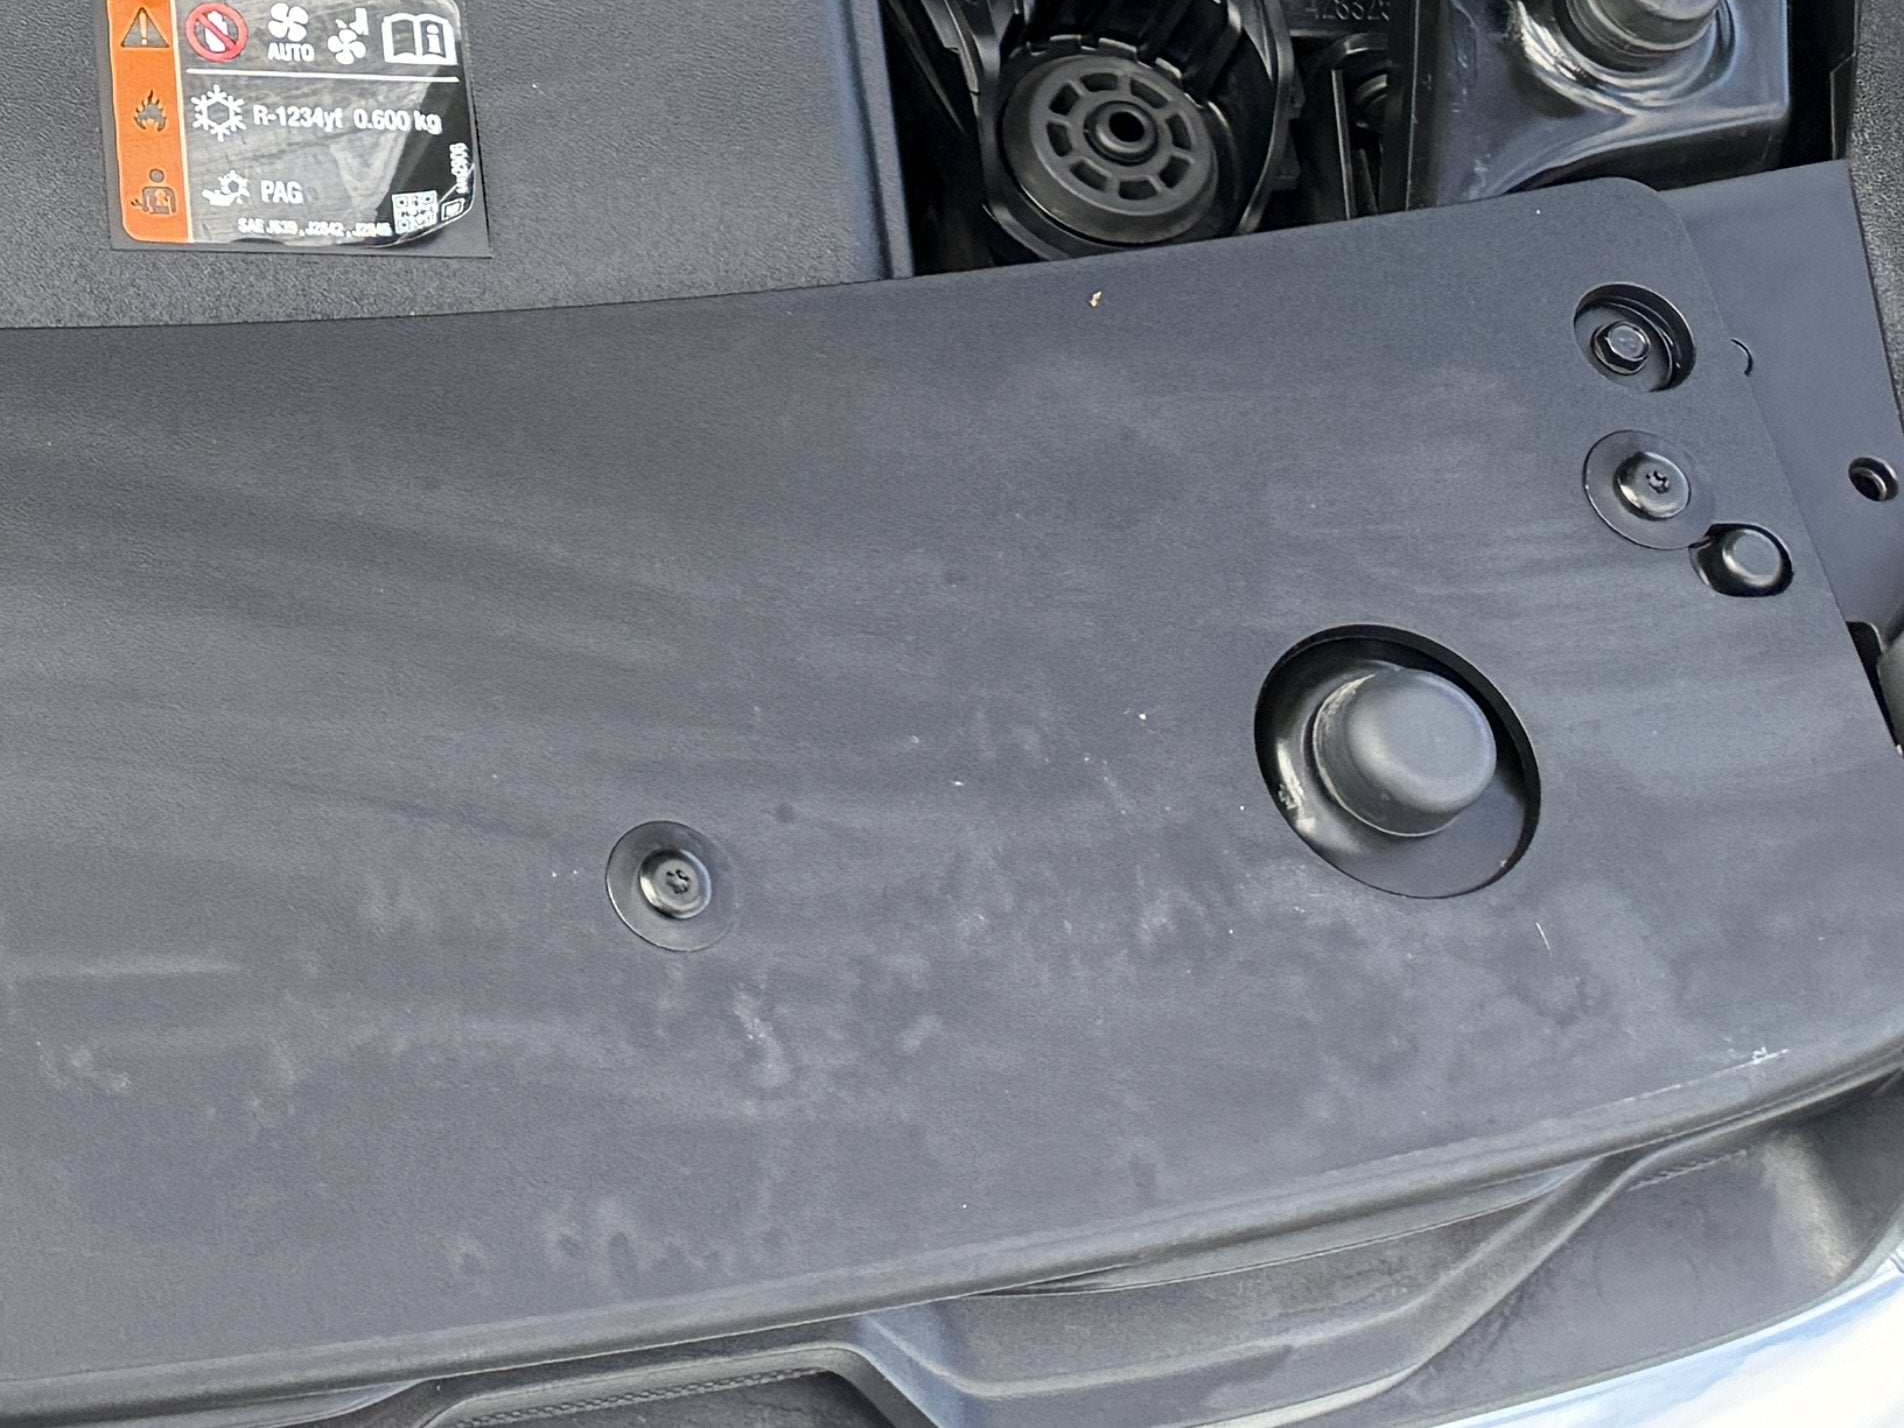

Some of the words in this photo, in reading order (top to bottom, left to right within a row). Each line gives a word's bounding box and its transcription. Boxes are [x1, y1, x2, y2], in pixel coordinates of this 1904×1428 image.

[267, 42, 315, 63] AUTO
[253, 104, 343, 133] R-1234yf
[353, 108, 411, 132] 0.600
[413, 109, 442, 135] kg
[260, 179, 304, 204] PAG
[238, 217, 265, 234] SAE
